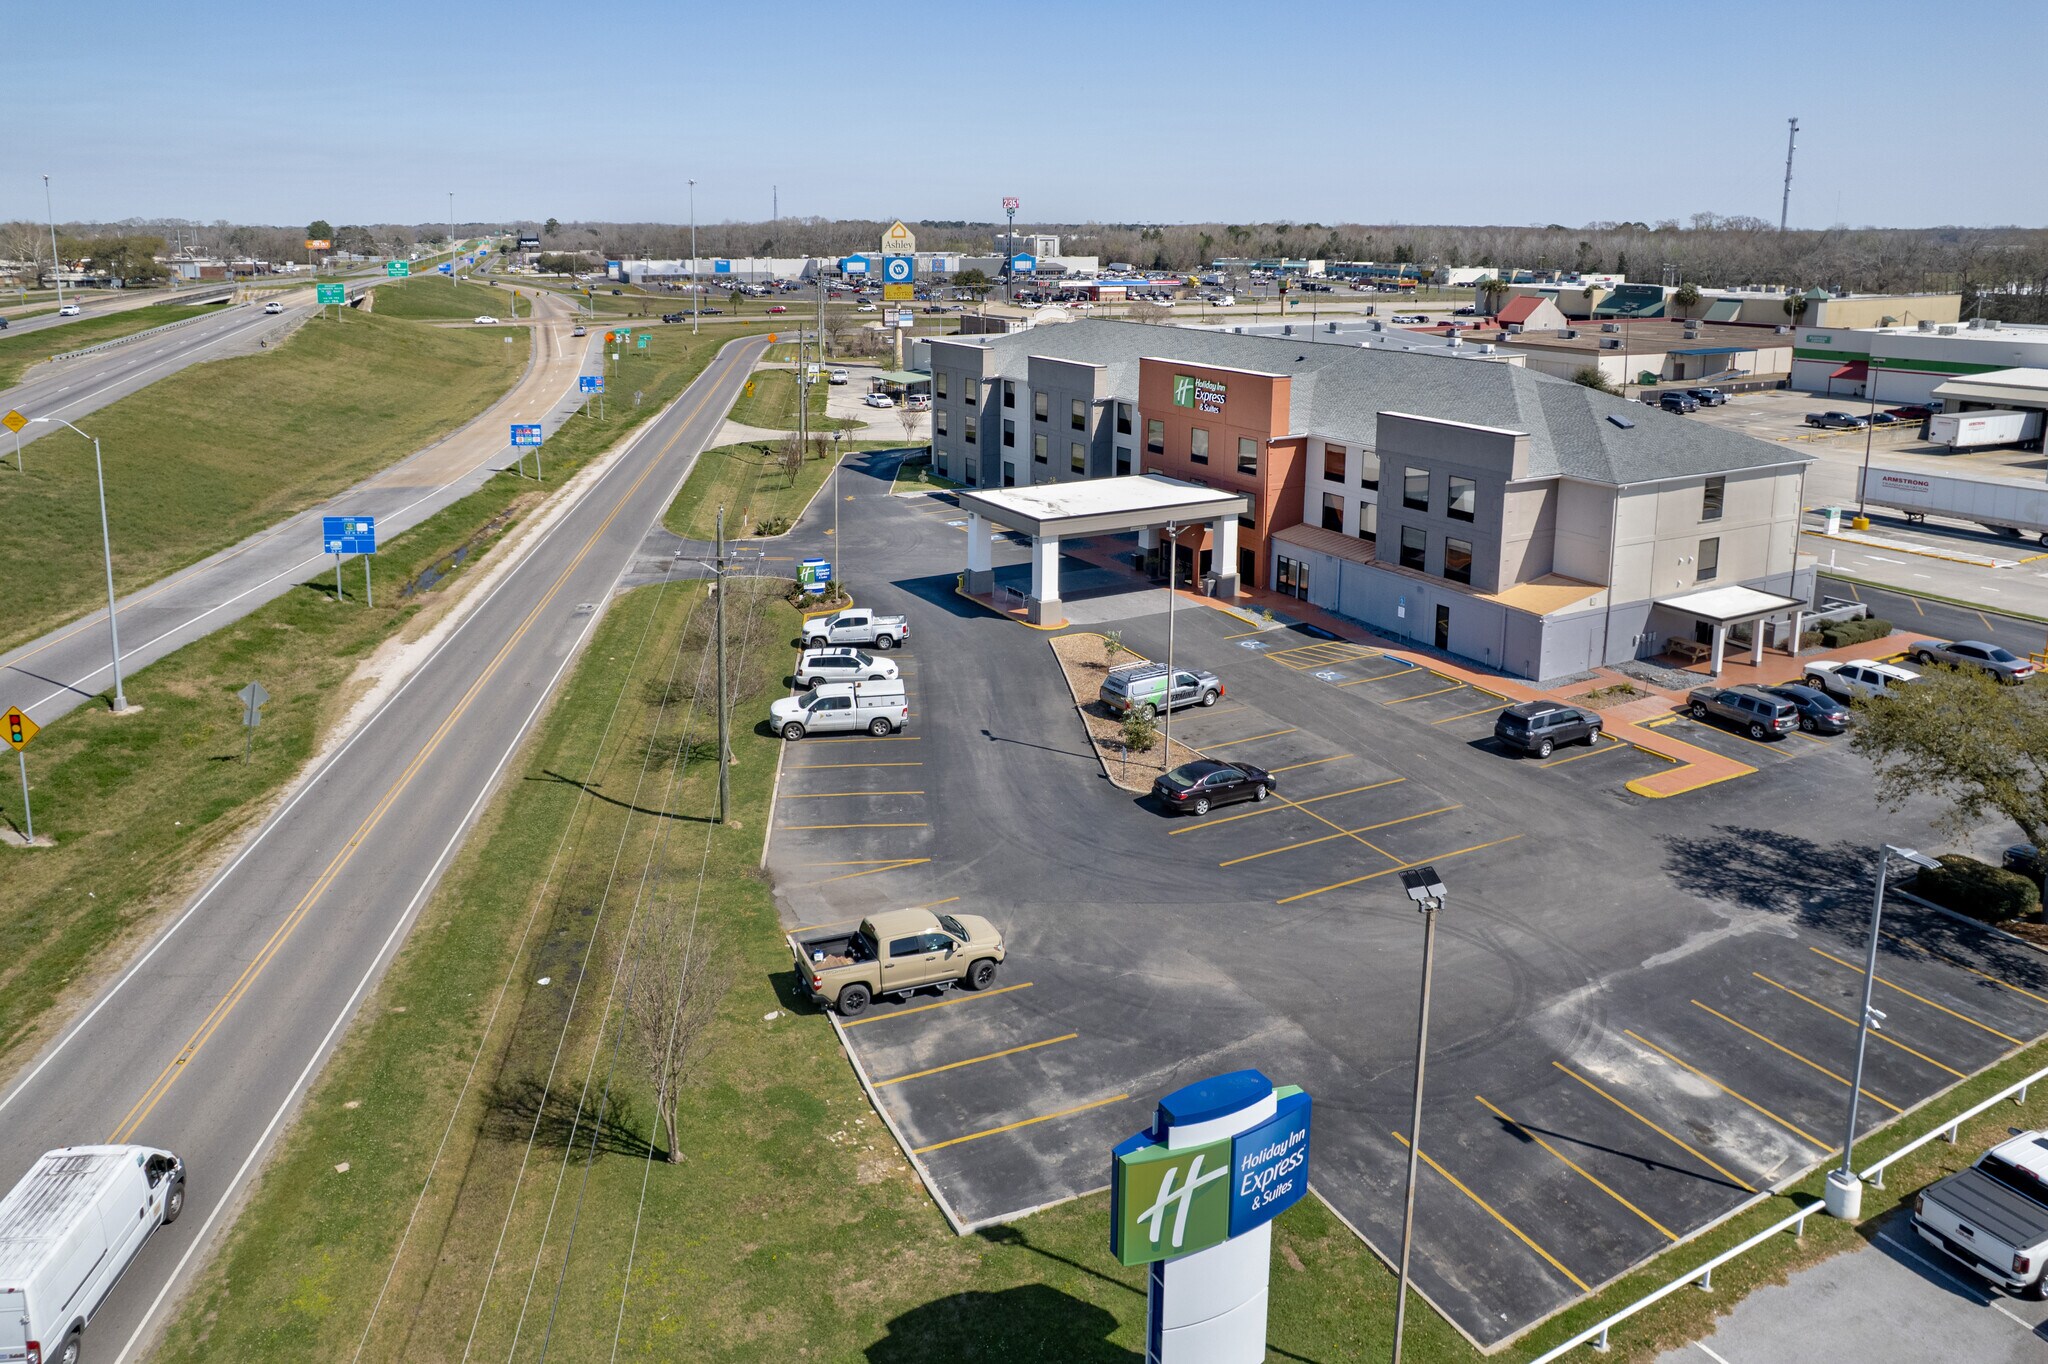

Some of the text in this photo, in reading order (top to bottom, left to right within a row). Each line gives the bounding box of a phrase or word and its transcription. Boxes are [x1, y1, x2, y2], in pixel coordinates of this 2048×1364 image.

[885, 240, 913, 249] Ashley
[1195, 378, 1226, 391] Holiday Inn
[1195, 387, 1226, 404] Express
[1199, 403, 1220, 414] & Suites
[1882, 476, 1929, 487] ARMSTRONG
[1241, 1128, 1305, 1172] Holiday Inn
[1240, 1147, 1305, 1196] Express
[1251, 1179, 1293, 1211] & Suites
